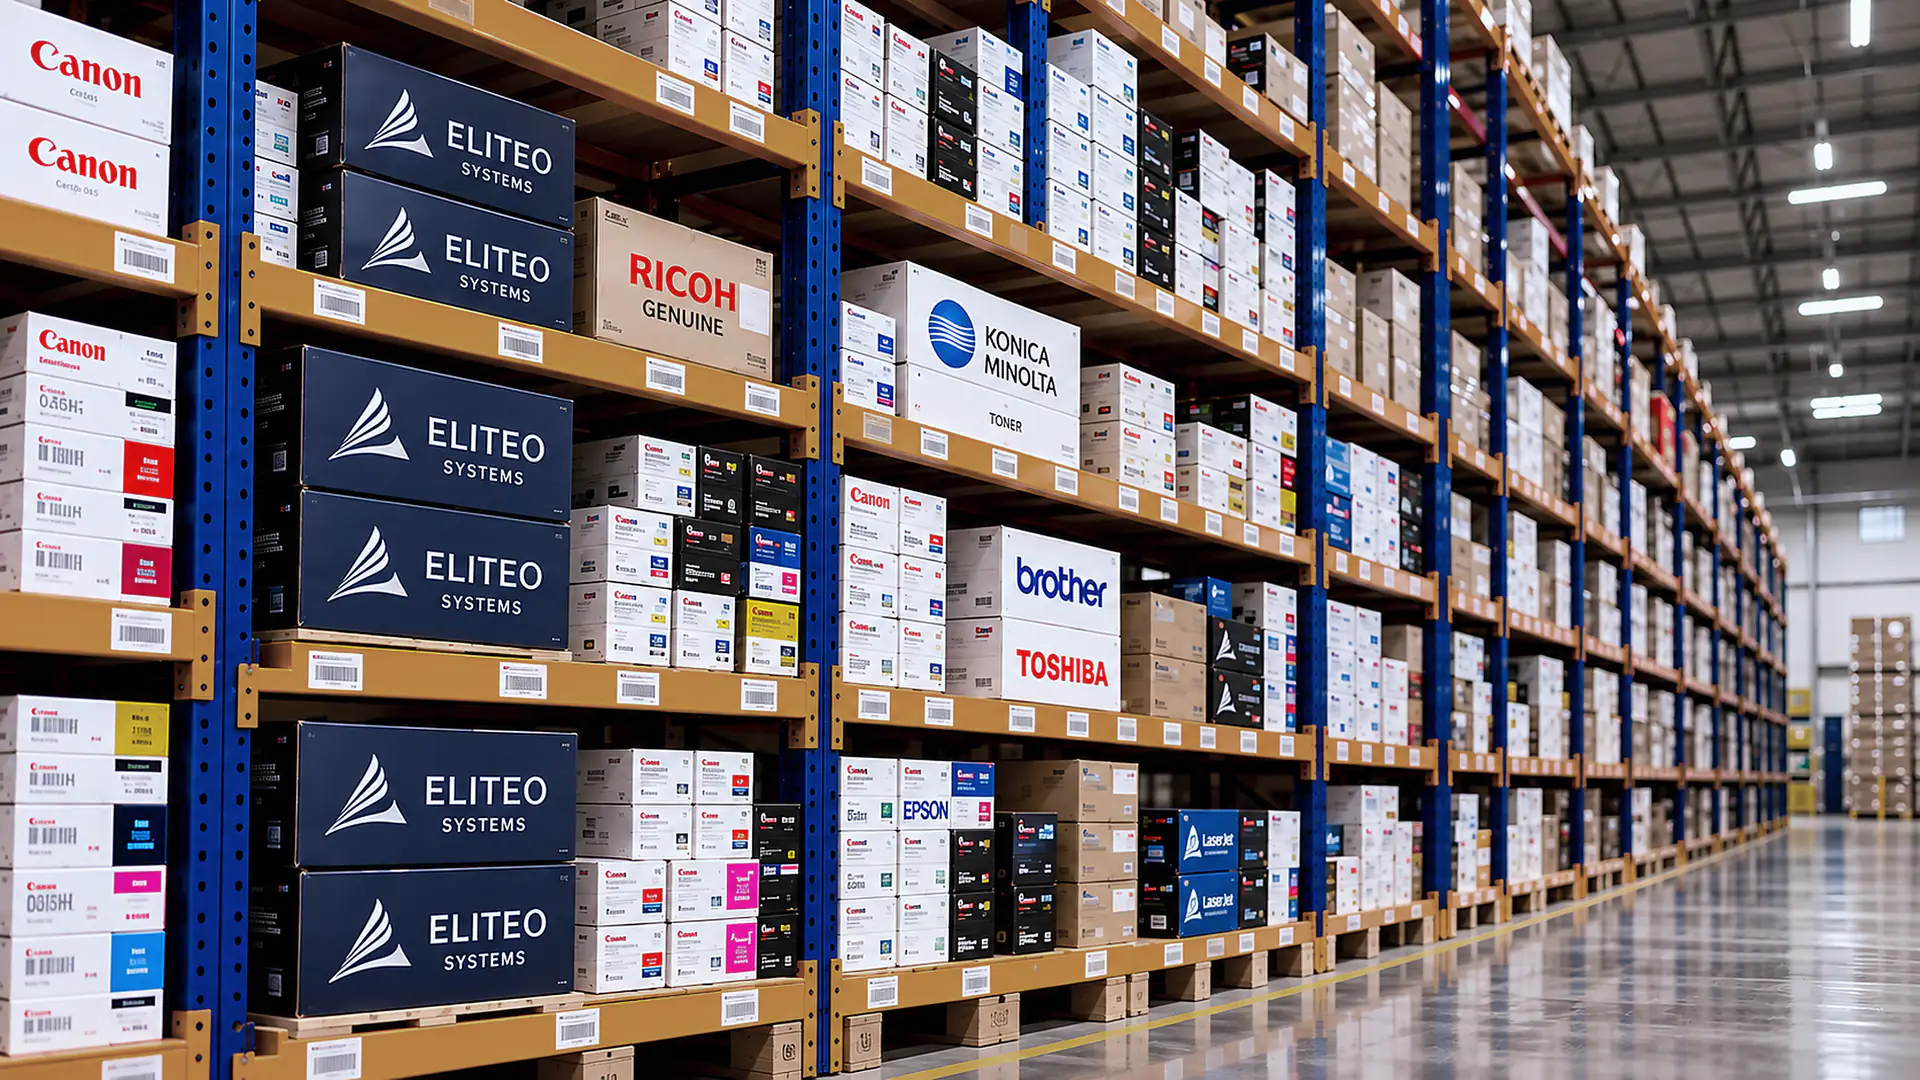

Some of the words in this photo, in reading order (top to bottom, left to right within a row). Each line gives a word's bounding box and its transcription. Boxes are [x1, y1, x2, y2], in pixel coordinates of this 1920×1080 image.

[30, 40, 142, 98] Canon
[28, 137, 137, 190] Canon
[448, 120, 552, 175] ELITEO
[461, 161, 533, 194] SYSTEMS
[446, 234, 550, 284] ELITEO
[459, 275, 531, 303] SYSTEMS
[630, 252, 736, 312] RICOH
[642, 299, 724, 337] GENUINE
[39, 329, 106, 362] Canon
[984, 325, 1051, 368] KONICA
[984, 354, 1058, 397] MINOLTA
[428, 416, 545, 463] ELITEO
[988, 411, 1023, 433] TONER
[443, 459, 524, 486] SYSTEMS
[850, 487, 890, 510] Canon
[426, 550, 543, 590] ELITEO
[1016, 556, 1107, 608] brother
[441, 594, 522, 615] SYSTEMS
[1016, 649, 1109, 687] TOSHIBA
[425, 775, 547, 806] ELITEO
[442, 817, 526, 833] SYSTEMS
[903, 800, 949, 820] EPSON
[429, 908, 547, 945] ELITEO
[444, 950, 526, 971] SYSTEMS
